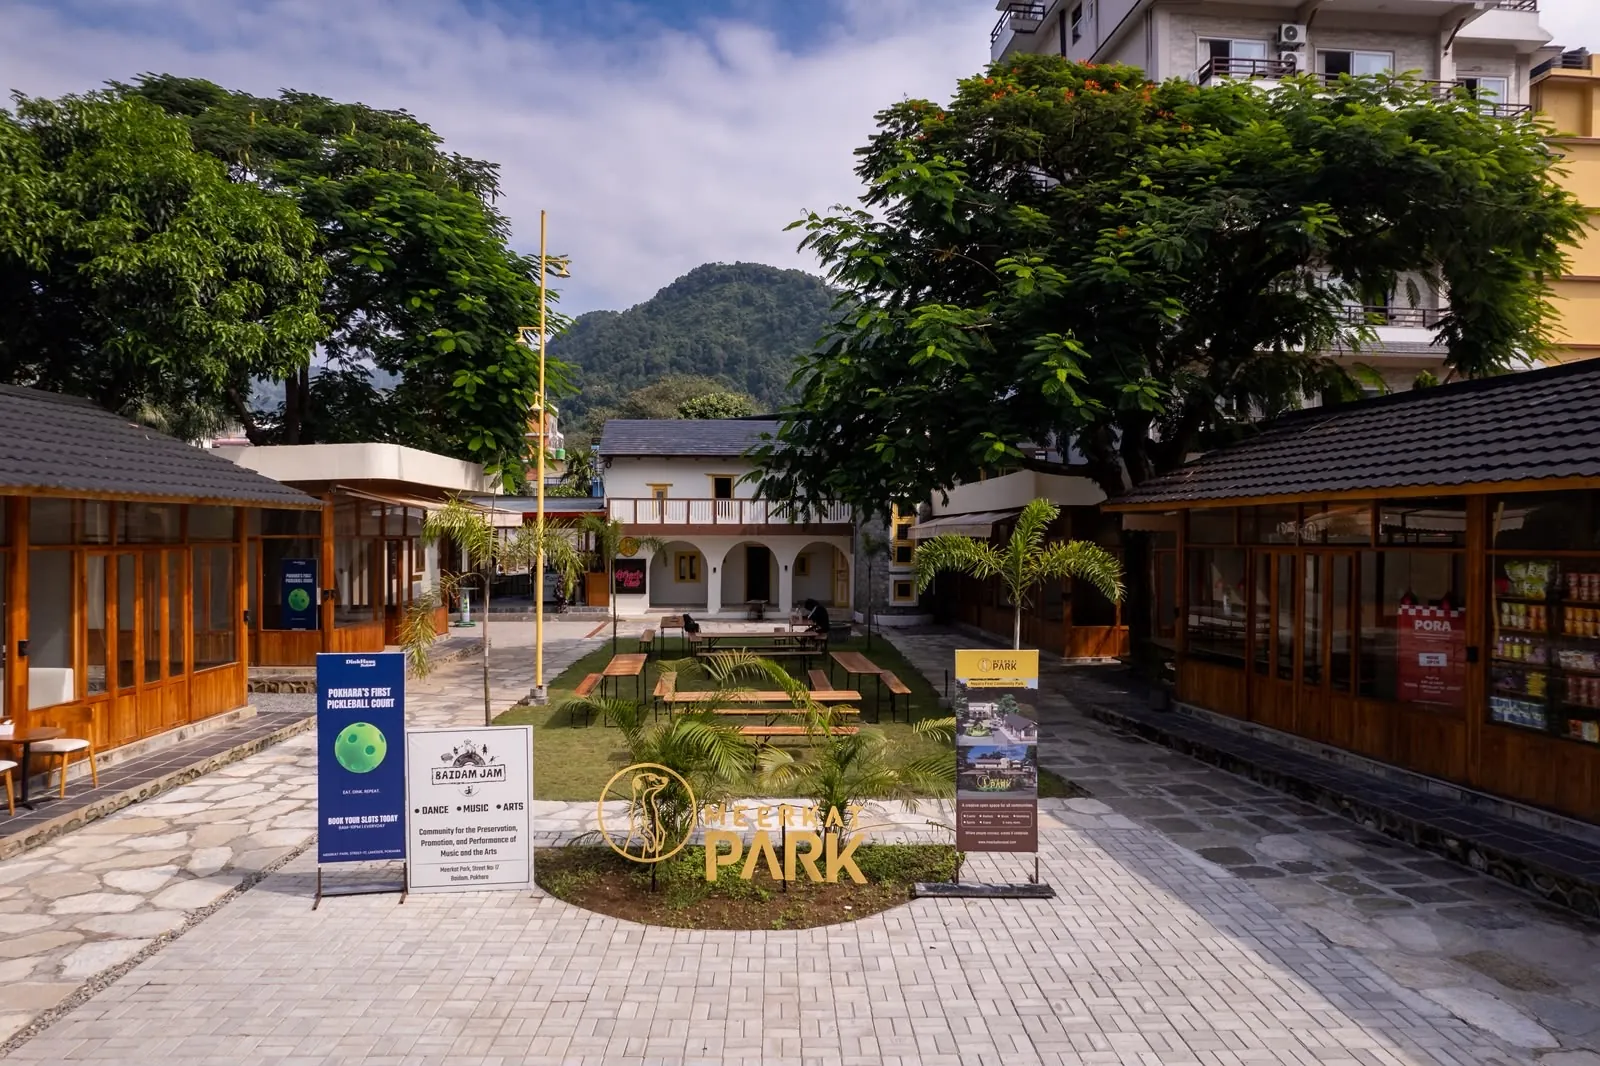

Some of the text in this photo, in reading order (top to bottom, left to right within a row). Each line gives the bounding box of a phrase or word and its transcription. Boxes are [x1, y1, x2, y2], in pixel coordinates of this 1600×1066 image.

[1415, 620, 1452, 632] PORA
[328, 687, 391, 698] POKHARA'S FIRST
[327, 698, 395, 709] PICKLEBALL COURT
[436, 768, 502, 780] BAIDAM JAM
[422, 802, 524, 814] DANCE MUSIC ARTS
[704, 804, 864, 828] MEERKAT
[419, 827, 454, 835] Community
[477, 824, 518, 832] Preservation,
[469, 836, 508, 844] Performance
[705, 830, 868, 884] PARK
